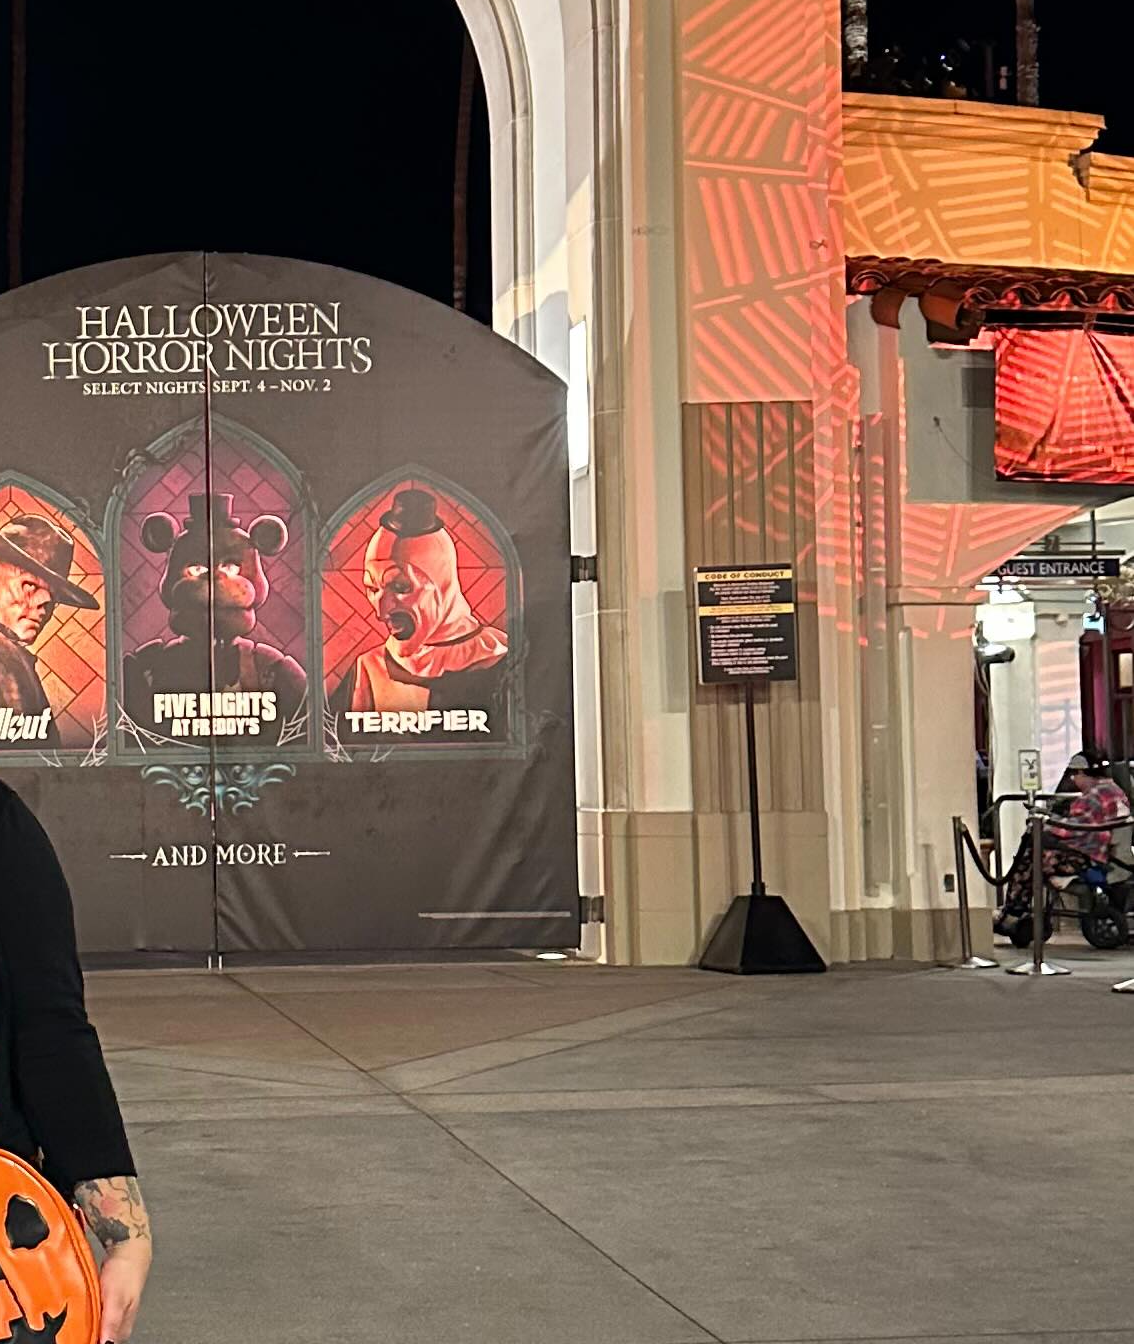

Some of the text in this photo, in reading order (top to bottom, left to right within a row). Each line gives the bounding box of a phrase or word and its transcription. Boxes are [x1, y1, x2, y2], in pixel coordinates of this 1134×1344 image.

[76, 302, 341, 339] HALLOWEEN
[42, 337, 372, 379] HORROR NIGHTS
[83, 382, 142, 395] SELECT
[145, 380, 206, 394] NIGHTS
[212, 380, 253, 393] SEPT.
[323, 379, 331, 391] 2
[997, 561, 1105, 575] GUEST ENTRANCE
[153, 691, 276, 723] FIVE NIGHTS
[171, 717, 260, 736] AT FREDDY'S
[345, 710, 490, 734] TERRIFIER
[152, 843, 287, 867] AND MORE
